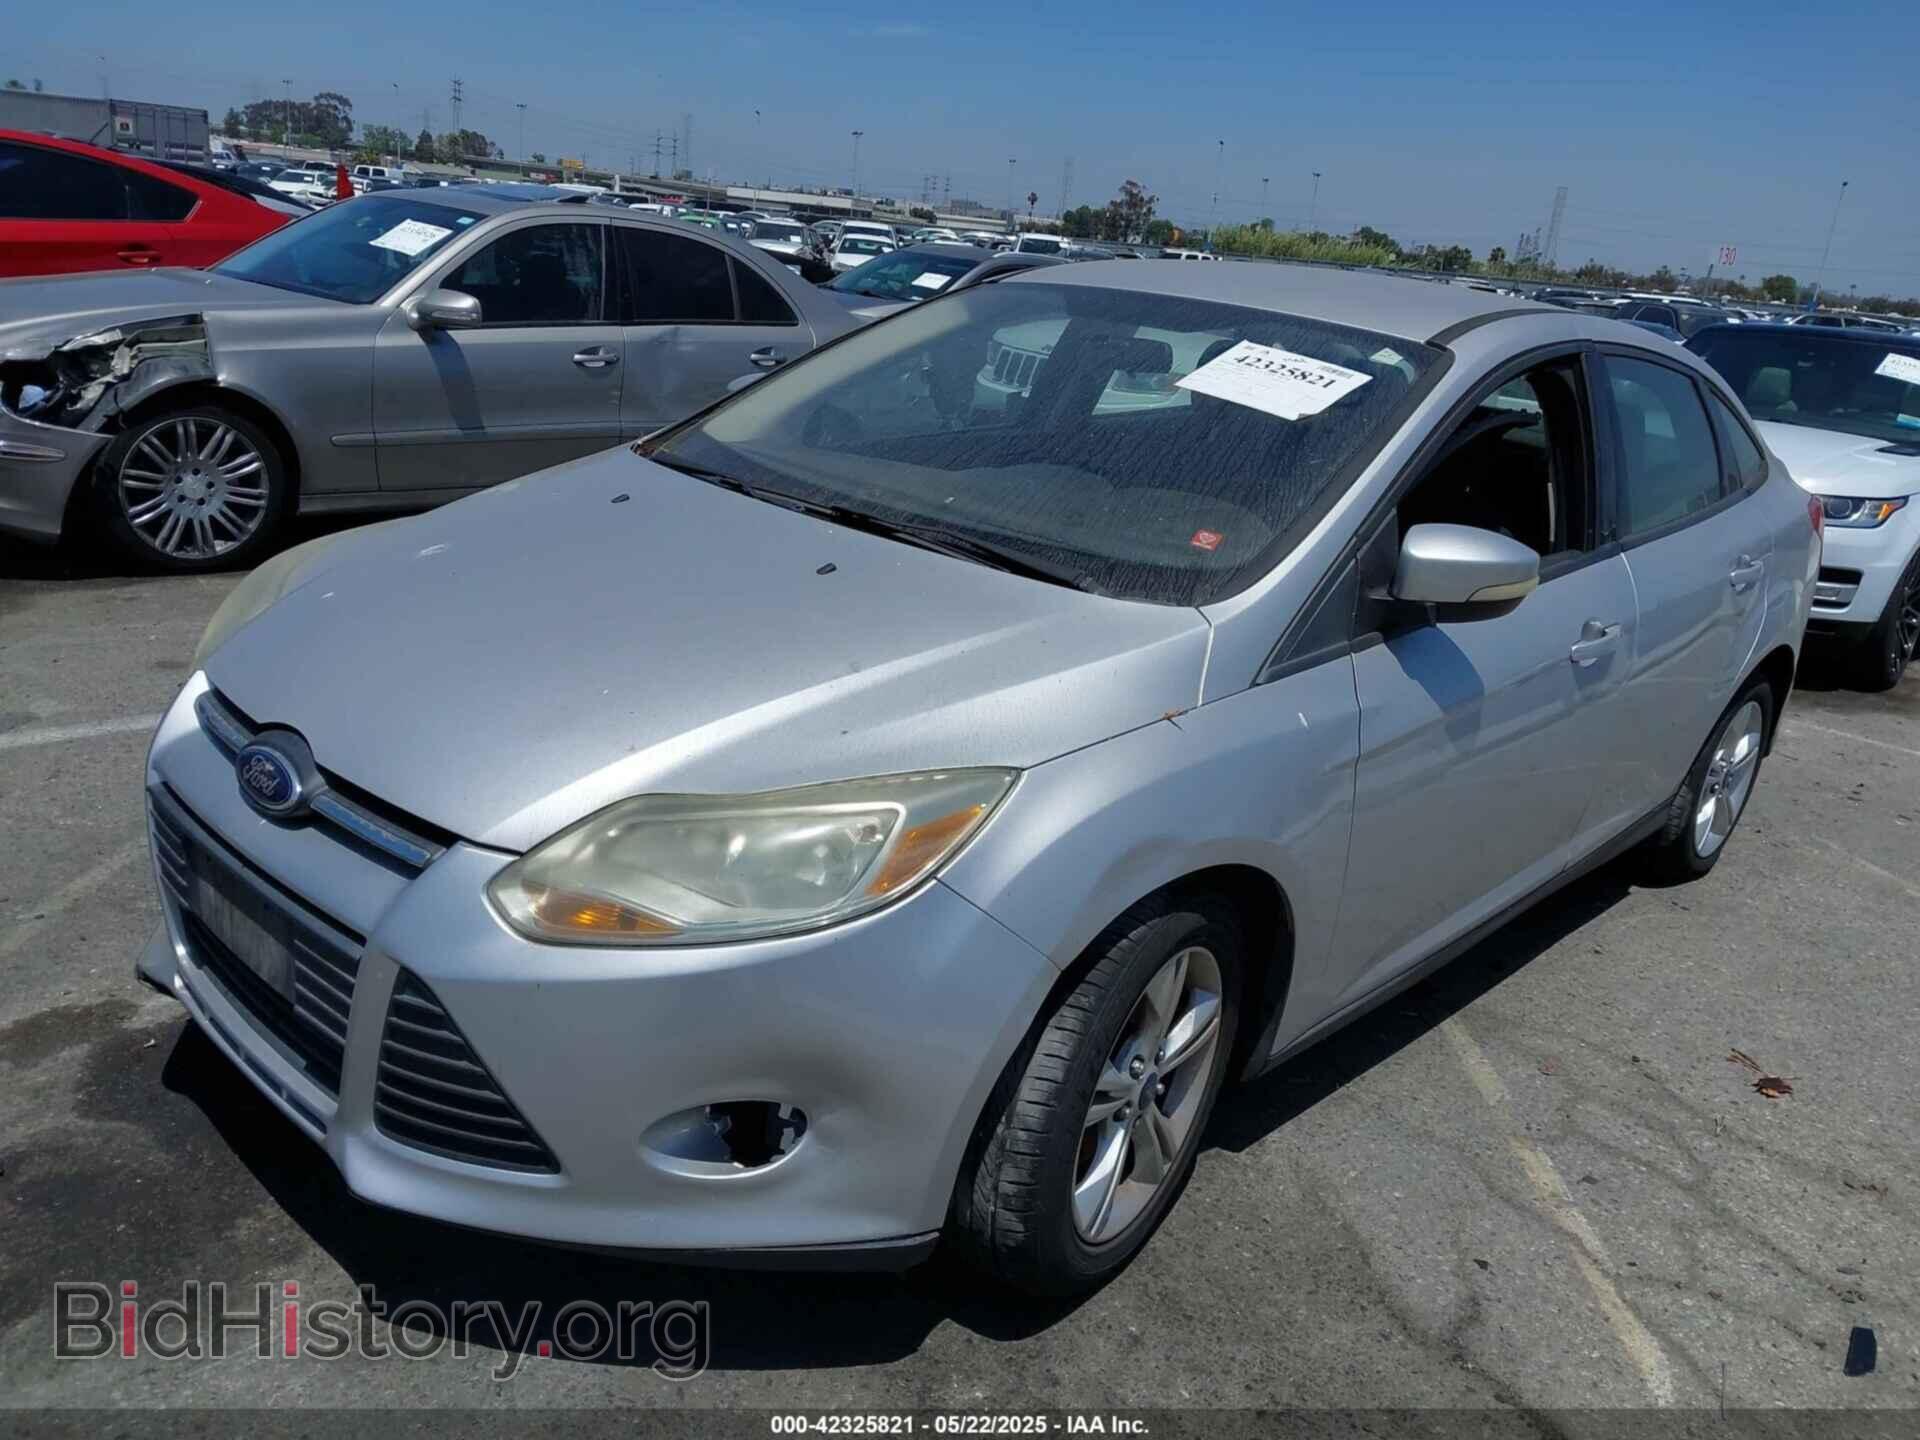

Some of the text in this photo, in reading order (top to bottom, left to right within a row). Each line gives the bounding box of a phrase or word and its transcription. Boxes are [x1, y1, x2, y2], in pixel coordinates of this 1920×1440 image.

[1718, 247, 1737, 266] 130
[1234, 355, 1336, 388] 42325821
[242, 754, 281, 797] Ford
